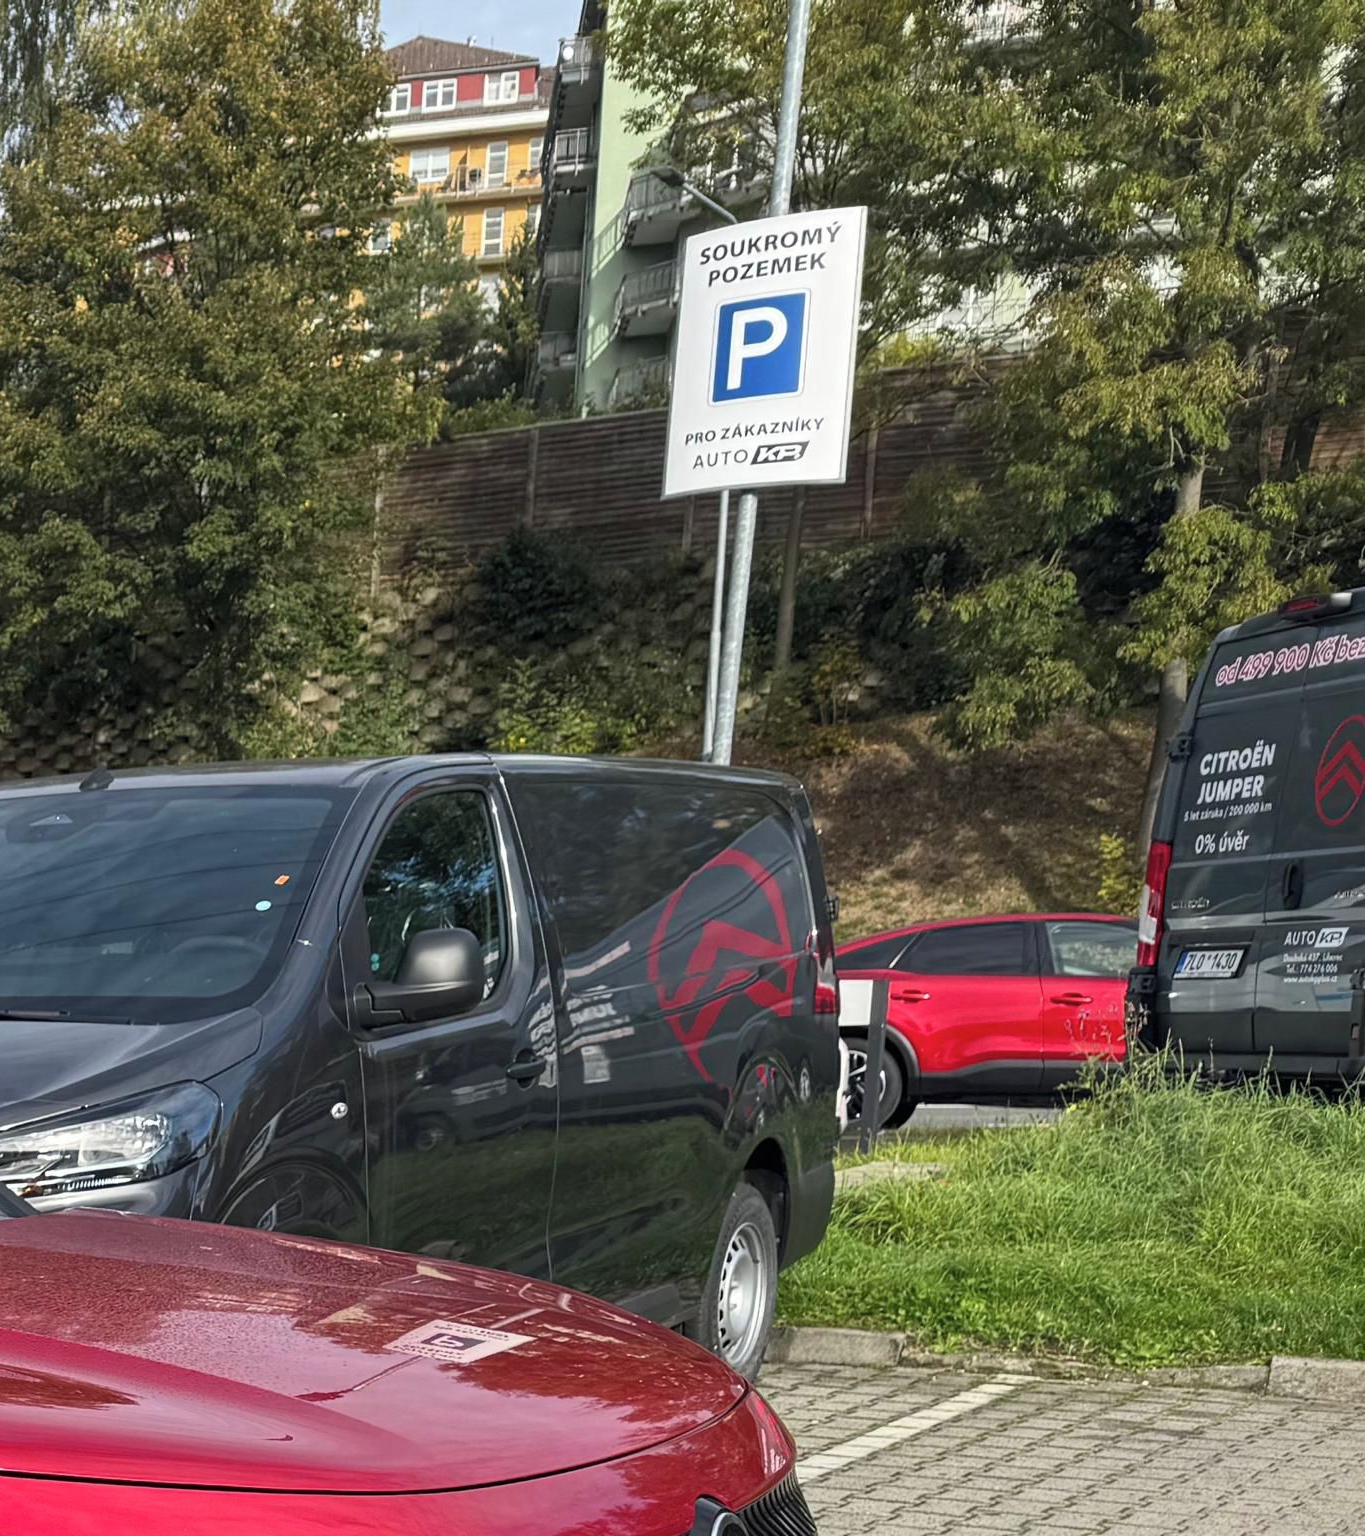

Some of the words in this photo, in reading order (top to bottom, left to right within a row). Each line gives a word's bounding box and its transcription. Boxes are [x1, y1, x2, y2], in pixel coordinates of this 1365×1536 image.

[699, 221, 842, 266] SOUKROMÝ
[708, 251, 827, 287] POZEMEK
[726, 306, 788, 390] P
[685, 430, 716, 446] PRO
[720, 416, 825, 440] ZÁKAZNÍKY
[693, 449, 748, 469] AUTO
[1215, 656, 1242, 687] od
[1238, 651, 1274, 681] 499
[1272, 643, 1310, 676] 900
[1309, 633, 1340, 668] Kč
[1200, 739, 1276, 776] CITROËN
[1197, 775, 1265, 805] JUMPER
[1229, 804, 1243, 817] 200
[1244, 802, 1259, 815] 000
[1260, 801, 1272, 812] km
[1195, 833, 1216, 854] 0%
[1219, 829, 1250, 853] úvěr
[1284, 930, 1316, 946] AUTO
[1211, 952, 1238, 970] 1430
